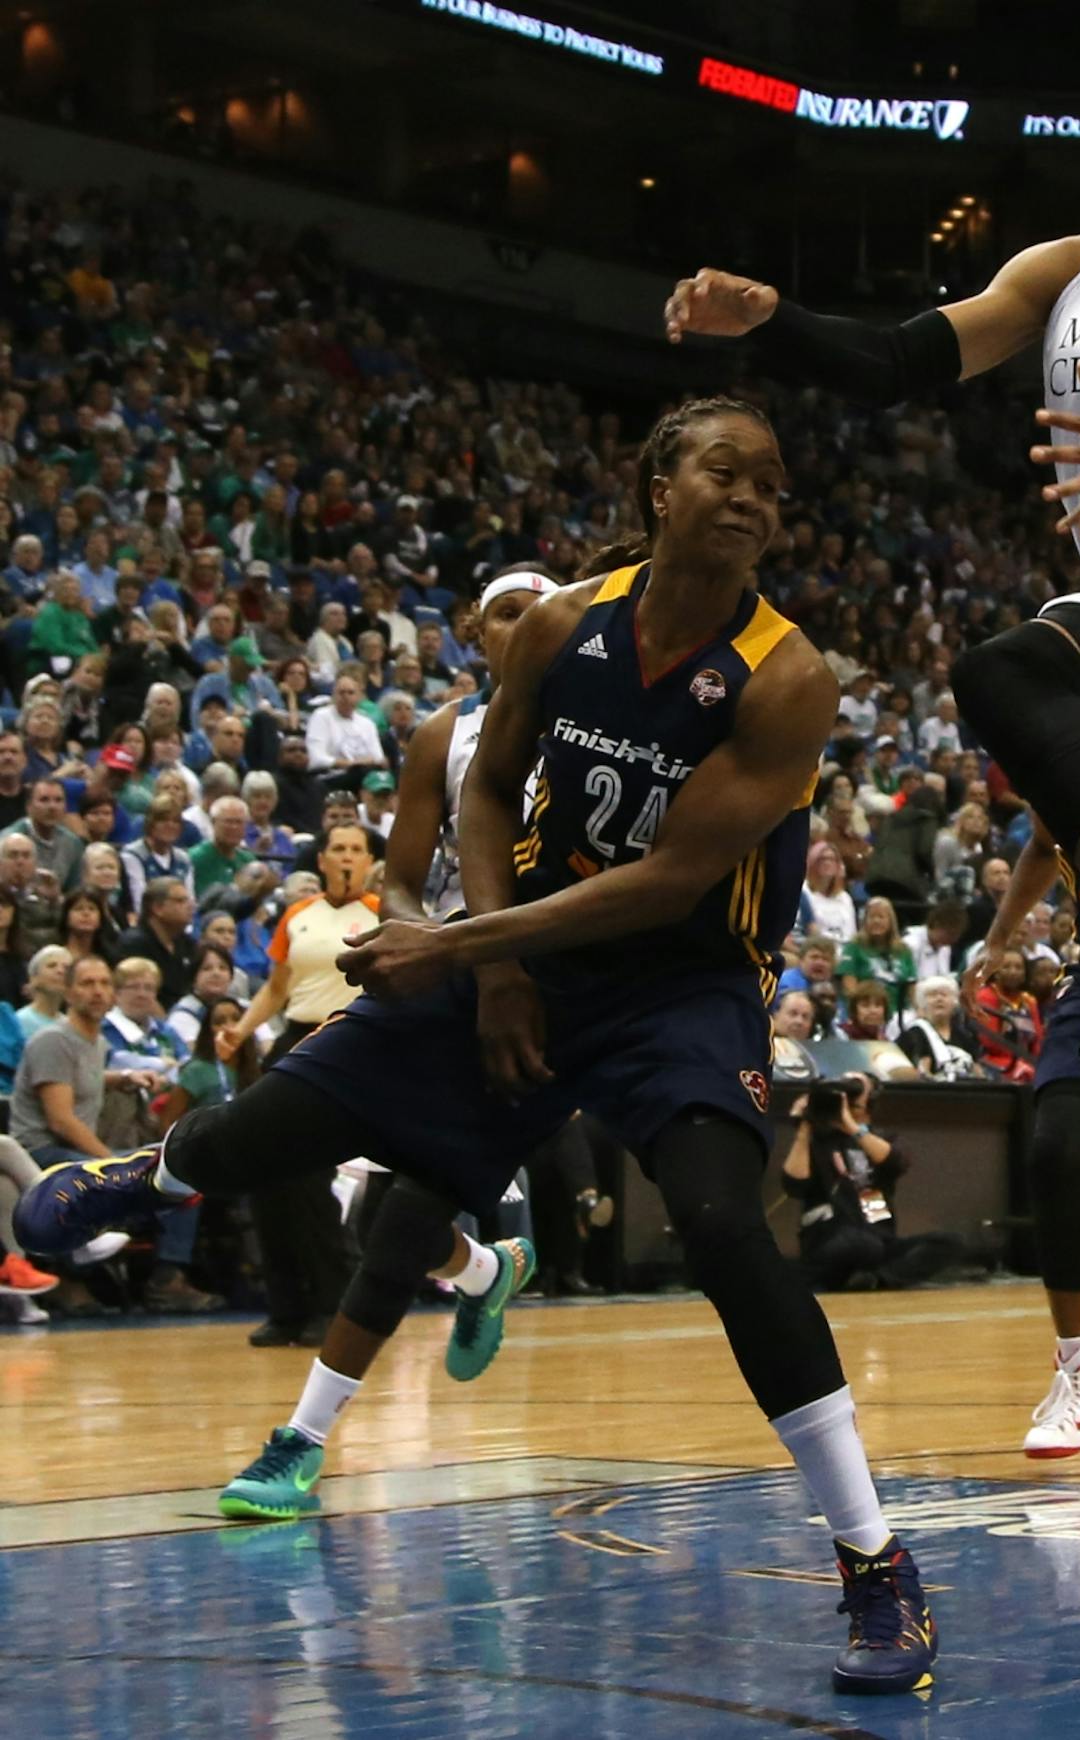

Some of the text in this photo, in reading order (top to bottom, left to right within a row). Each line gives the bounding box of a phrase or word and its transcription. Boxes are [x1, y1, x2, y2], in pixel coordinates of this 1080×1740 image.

[699, 58, 932, 129] FEDERATED INSURANCE
[584, 764, 669, 859] 24
